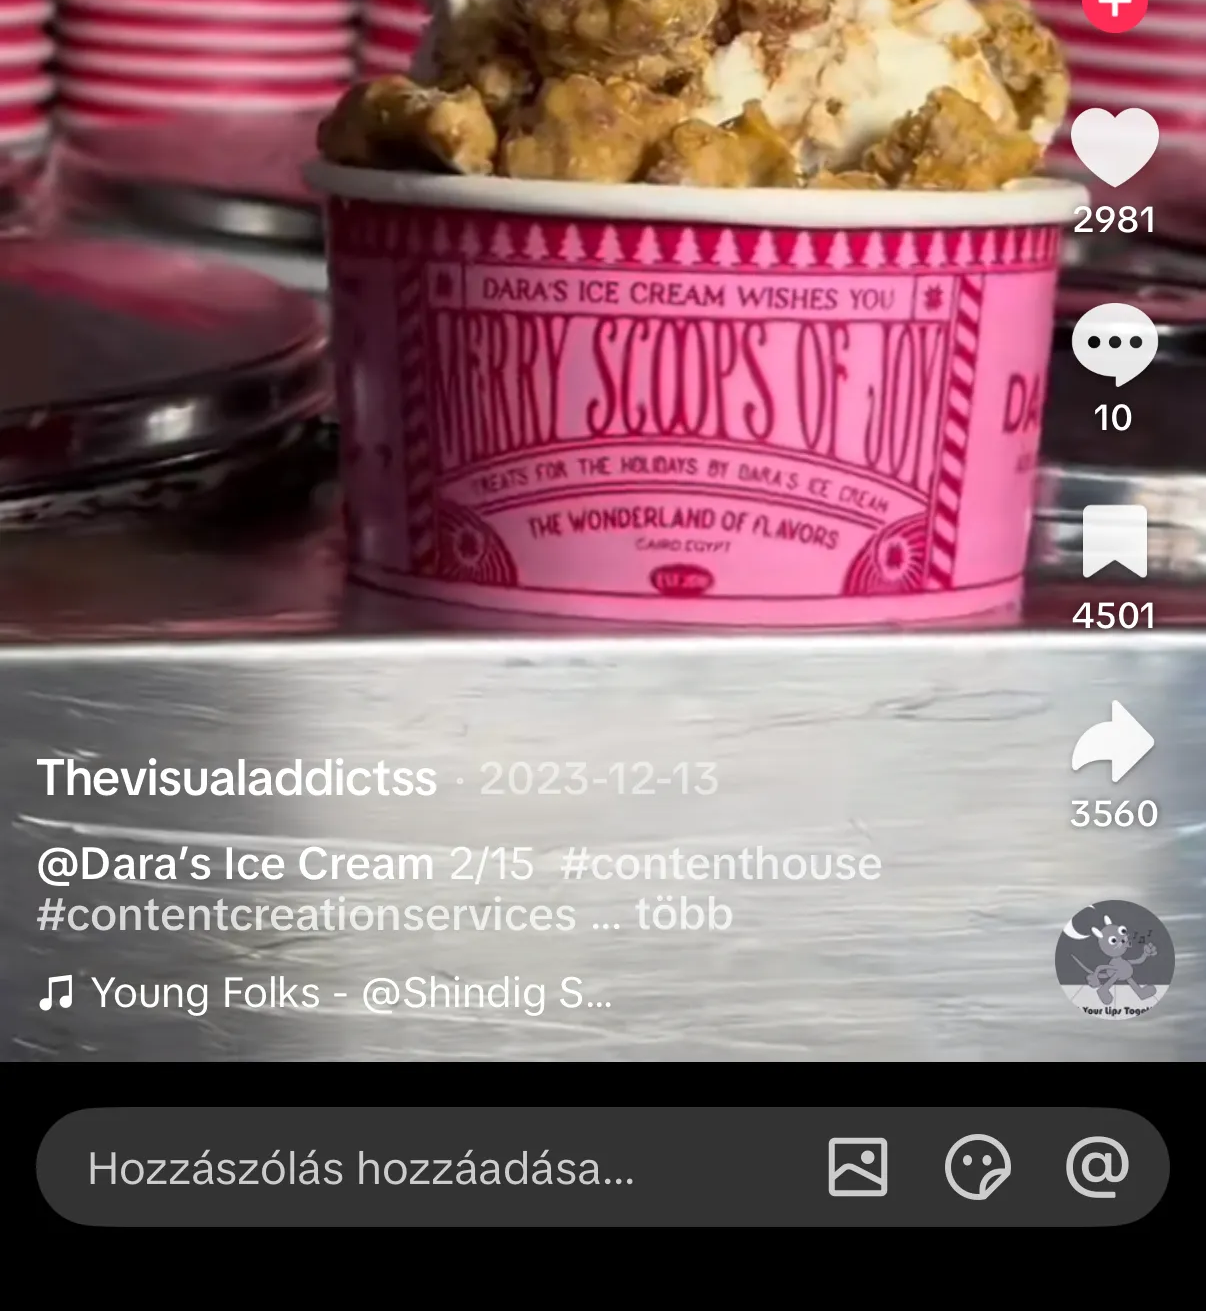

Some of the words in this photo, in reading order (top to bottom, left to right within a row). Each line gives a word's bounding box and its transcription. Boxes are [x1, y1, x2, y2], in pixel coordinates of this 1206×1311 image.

[483, 277, 568, 302] DARA'S
[578, 279, 620, 305] ICE
[630, 281, 725, 307] CREAM
[737, 285, 839, 310] WISHES
[849, 288, 895, 312] YOU
[430, 311, 571, 474] MERRY
[586, 315, 775, 444] SCOOPS
[796, 318, 850, 462] OF
[472, 467, 529, 497] TREATS
[535, 460, 568, 483] FOR
[576, 456, 611, 477] THE
[620, 455, 699, 477] HOLIDAYS
[706, 459, 730, 480] BY
[737, 462, 800, 492] DARA'S
[807, 476, 833, 500] ICE
[838, 485, 891, 515] CREAM
[529, 514, 562, 540] THE
[568, 504, 715, 534] WONDERLAND
[720, 510, 748, 533] OF
[752, 513, 841, 551] FLAVORS
